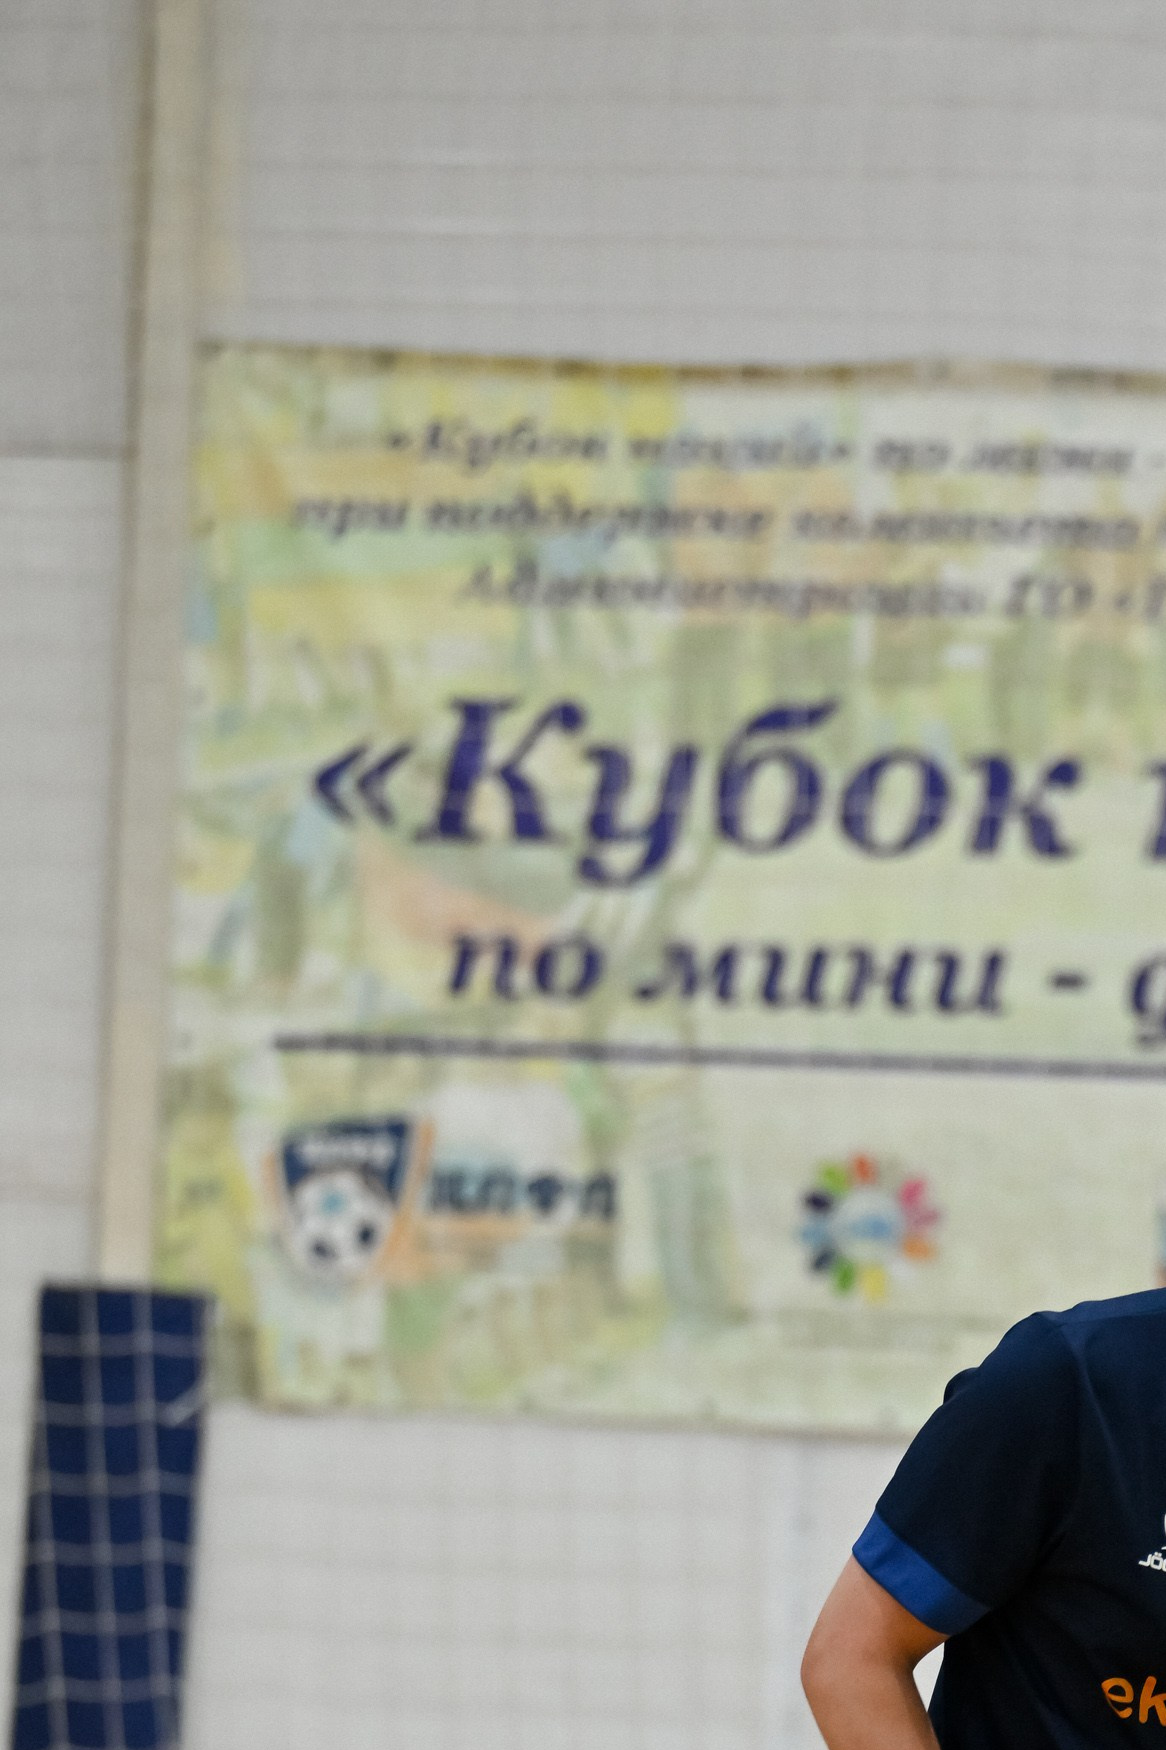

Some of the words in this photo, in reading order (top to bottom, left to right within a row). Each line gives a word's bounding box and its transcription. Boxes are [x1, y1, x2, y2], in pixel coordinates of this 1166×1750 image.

[310, 695, 1090, 889] «Кубок
[445, 929, 605, 1000] по
[631, 938, 1011, 1016] мини
